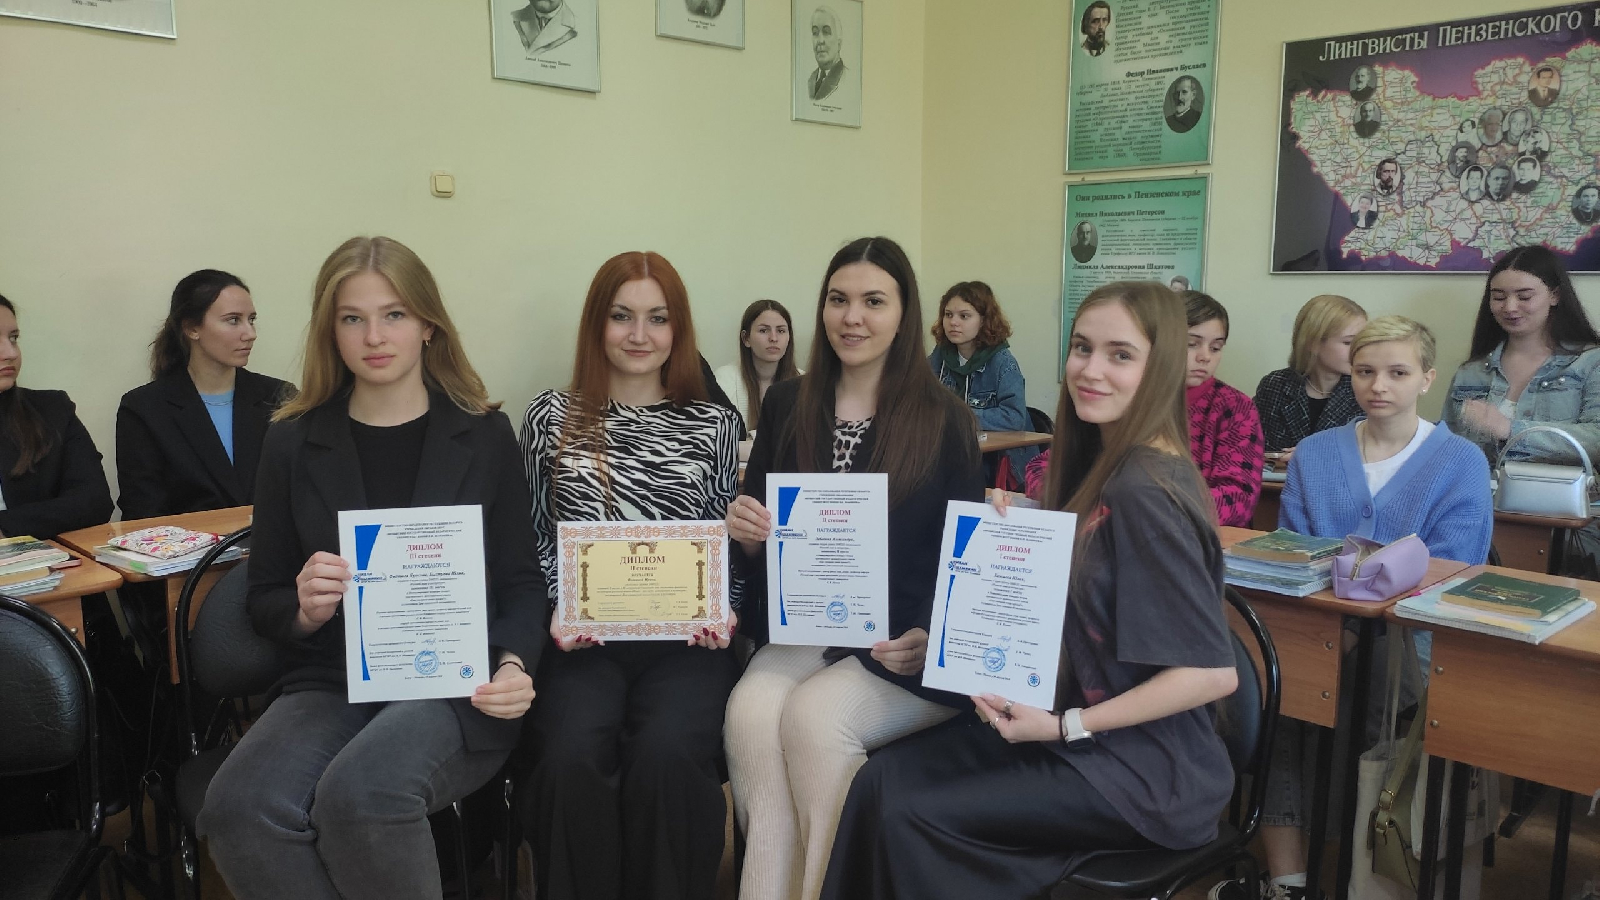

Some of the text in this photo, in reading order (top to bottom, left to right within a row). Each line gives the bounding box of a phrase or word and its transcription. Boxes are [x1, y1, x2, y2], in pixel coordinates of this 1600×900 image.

[1319, 31, 1429, 61] ЛИНГВИСТЫ
[1438, 10, 1583, 47] ПЕНЗЕНСКОГО
[1075, 194, 1091, 202] Они
[1091, 193, 1126, 203] родились
[1134, 190, 1180, 200] Пензенском
[1181, 189, 1201, 198] крае
[819, 509, 851, 517] ДИПЛОМ
[405, 543, 444, 553] ДИПЛОМ
[995, 544, 1031, 555] ДИПЛОМ
[619, 555, 666, 565] ДИПЛОМ
